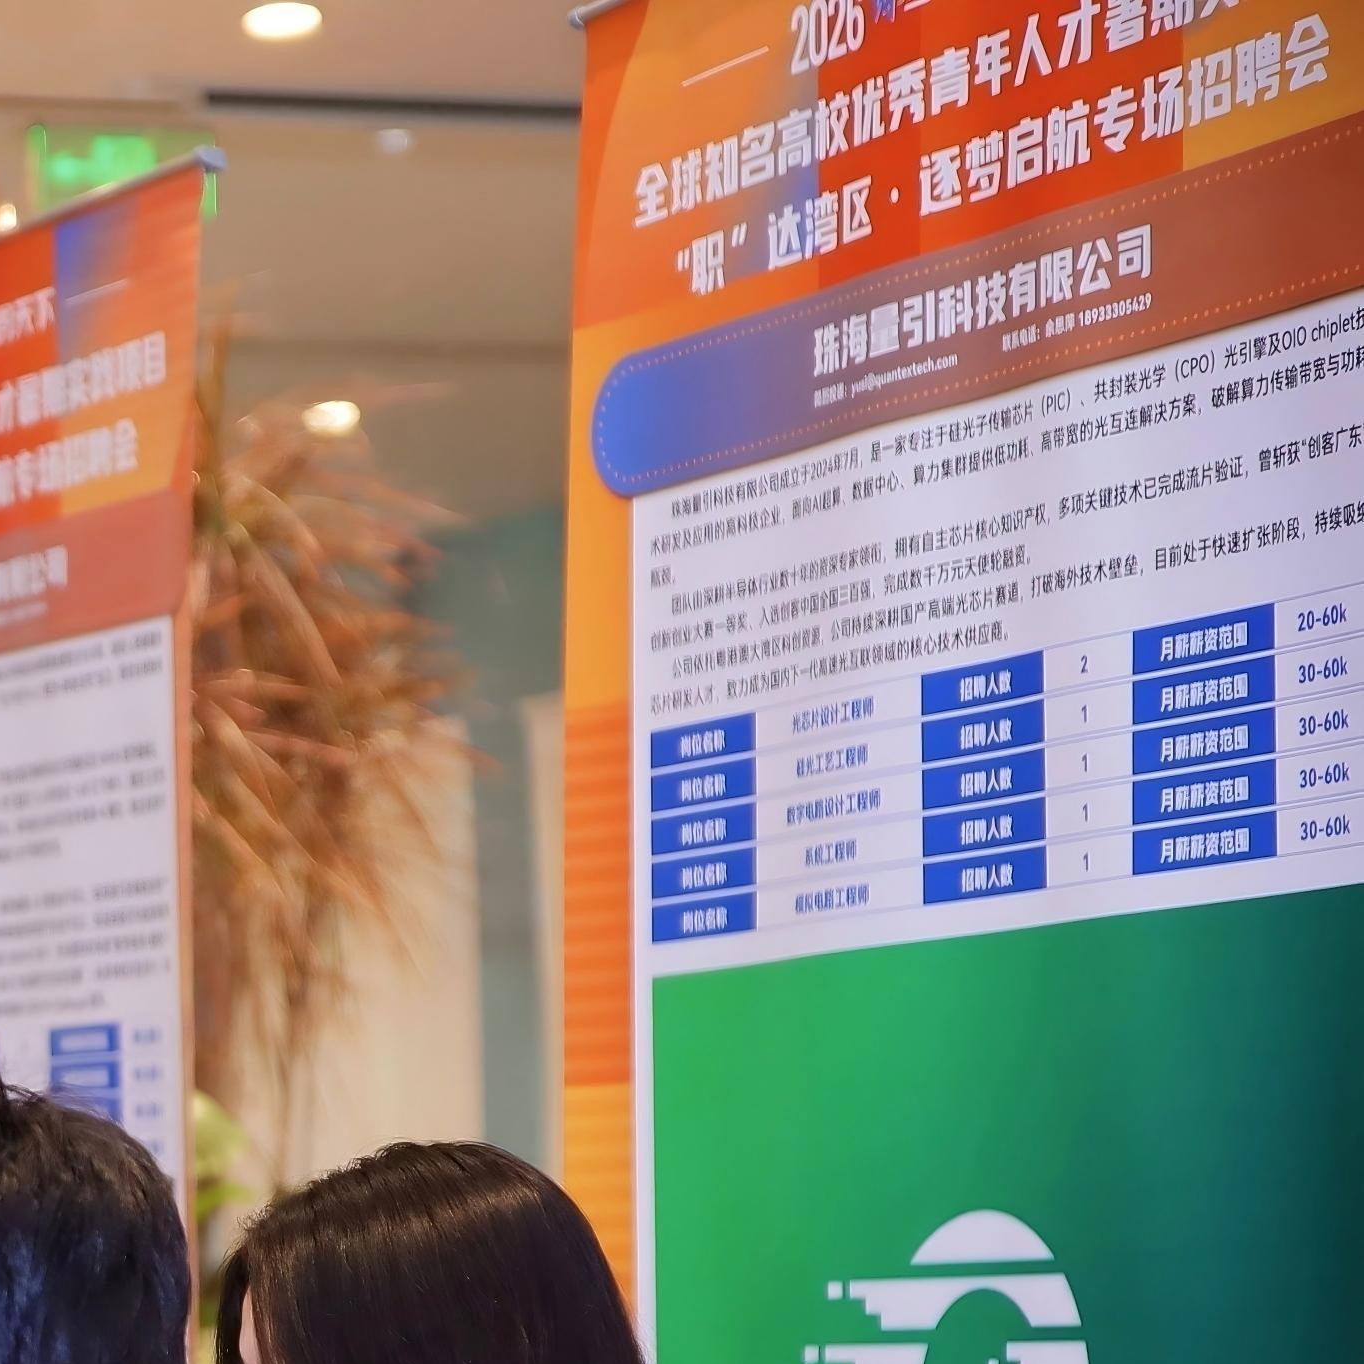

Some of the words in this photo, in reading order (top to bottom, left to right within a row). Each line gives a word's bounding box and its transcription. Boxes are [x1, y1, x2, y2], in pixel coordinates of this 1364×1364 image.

[790, 1, 865, 74] 2026
[814, 224, 1153, 377] 珠海量引科技有限公司
[1080, 656, 1088, 674] 2
[1297, 608, 1347, 632] 20-60k
[1081, 705, 1087, 723] 1
[1298, 657, 1348, 683] 30-60k
[1082, 754, 1088, 772] 1
[1299, 708, 1349, 736] 30-60k
[1082, 804, 1088, 822] 1
[1299, 761, 1350, 788] 30-60k
[1083, 853, 1089, 872] 1
[1300, 814, 1351, 841] 30-60k
